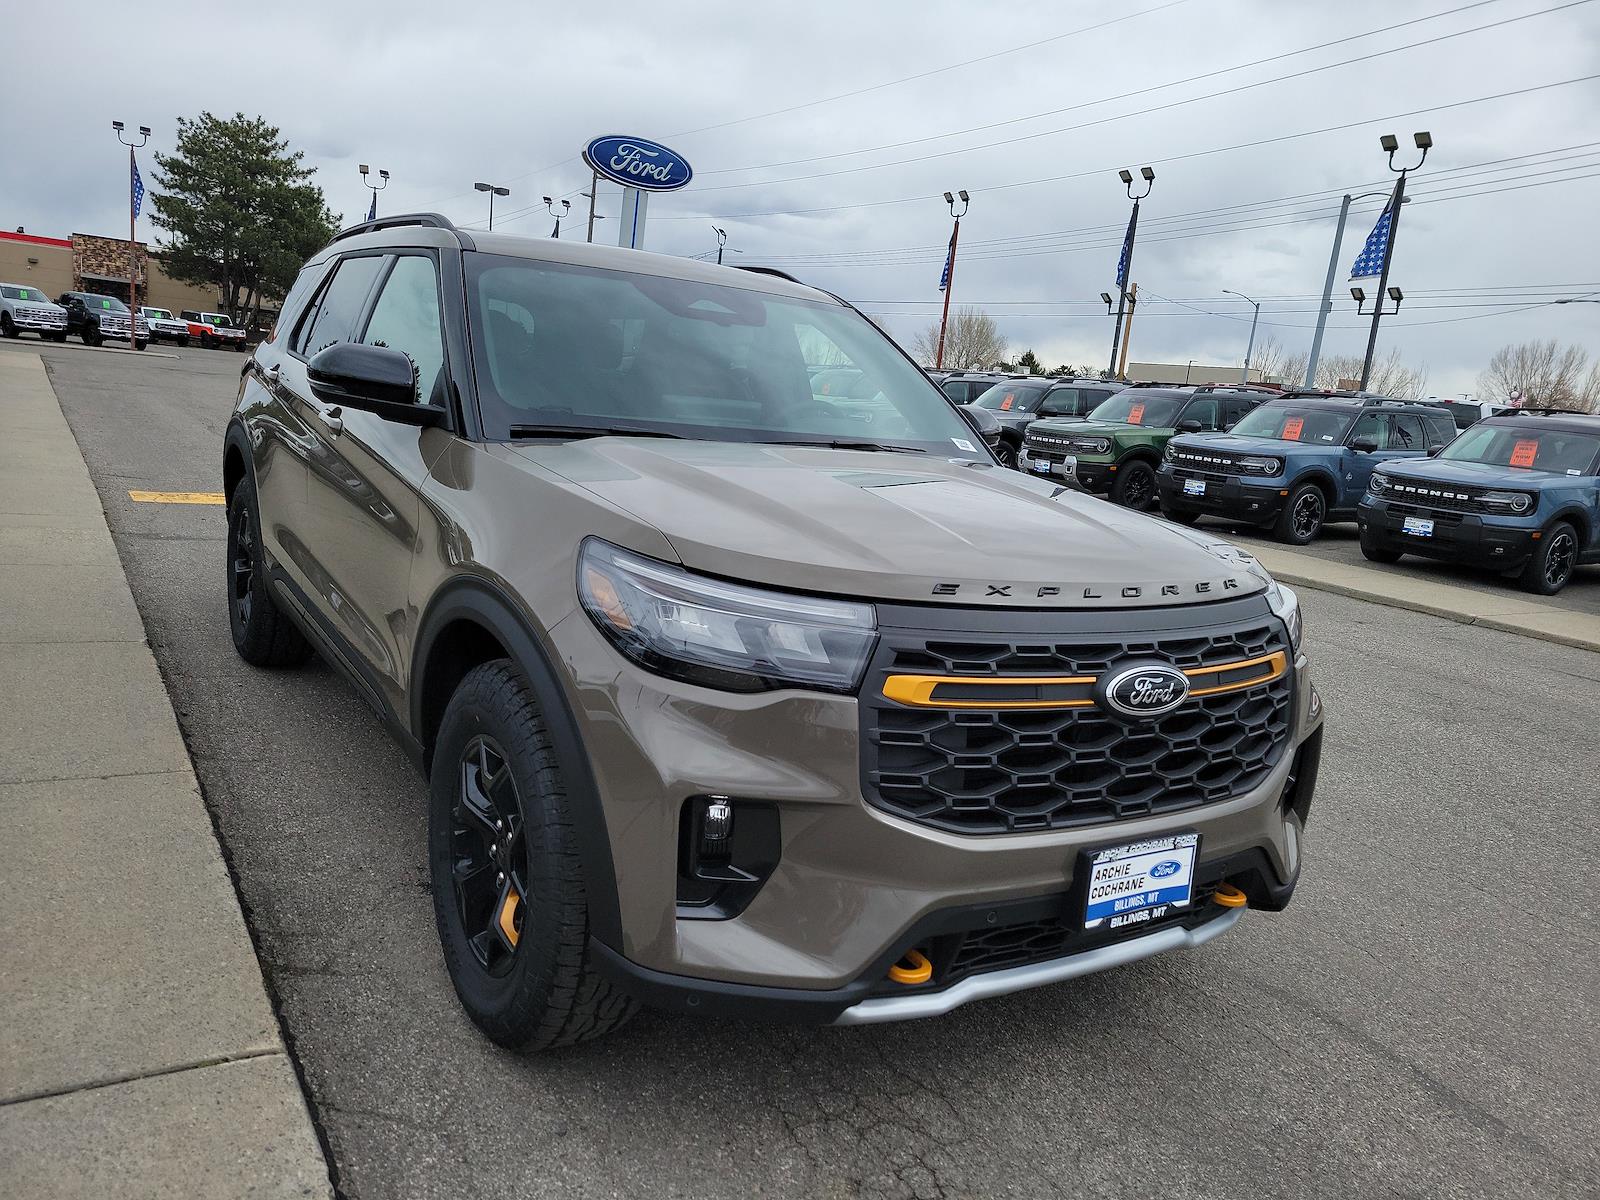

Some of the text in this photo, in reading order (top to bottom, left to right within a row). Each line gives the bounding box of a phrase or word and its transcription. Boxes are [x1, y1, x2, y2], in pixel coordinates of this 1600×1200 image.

[609, 143, 674, 181] Ford
[1178, 453, 1232, 465] BRONCO
[1394, 485, 1469, 500] BRONCO
[932, 578, 1239, 598] EXPLORER
[1130, 677, 1175, 705] Ford
[1094, 863, 1131, 881] ARCHIE
[1155, 863, 1176, 876] Ford
[1091, 877, 1145, 899] COCHRANE
[1114, 892, 1159, 911] BILLINGS, MT
[1110, 906, 1167, 928] BILLINGS, MT
